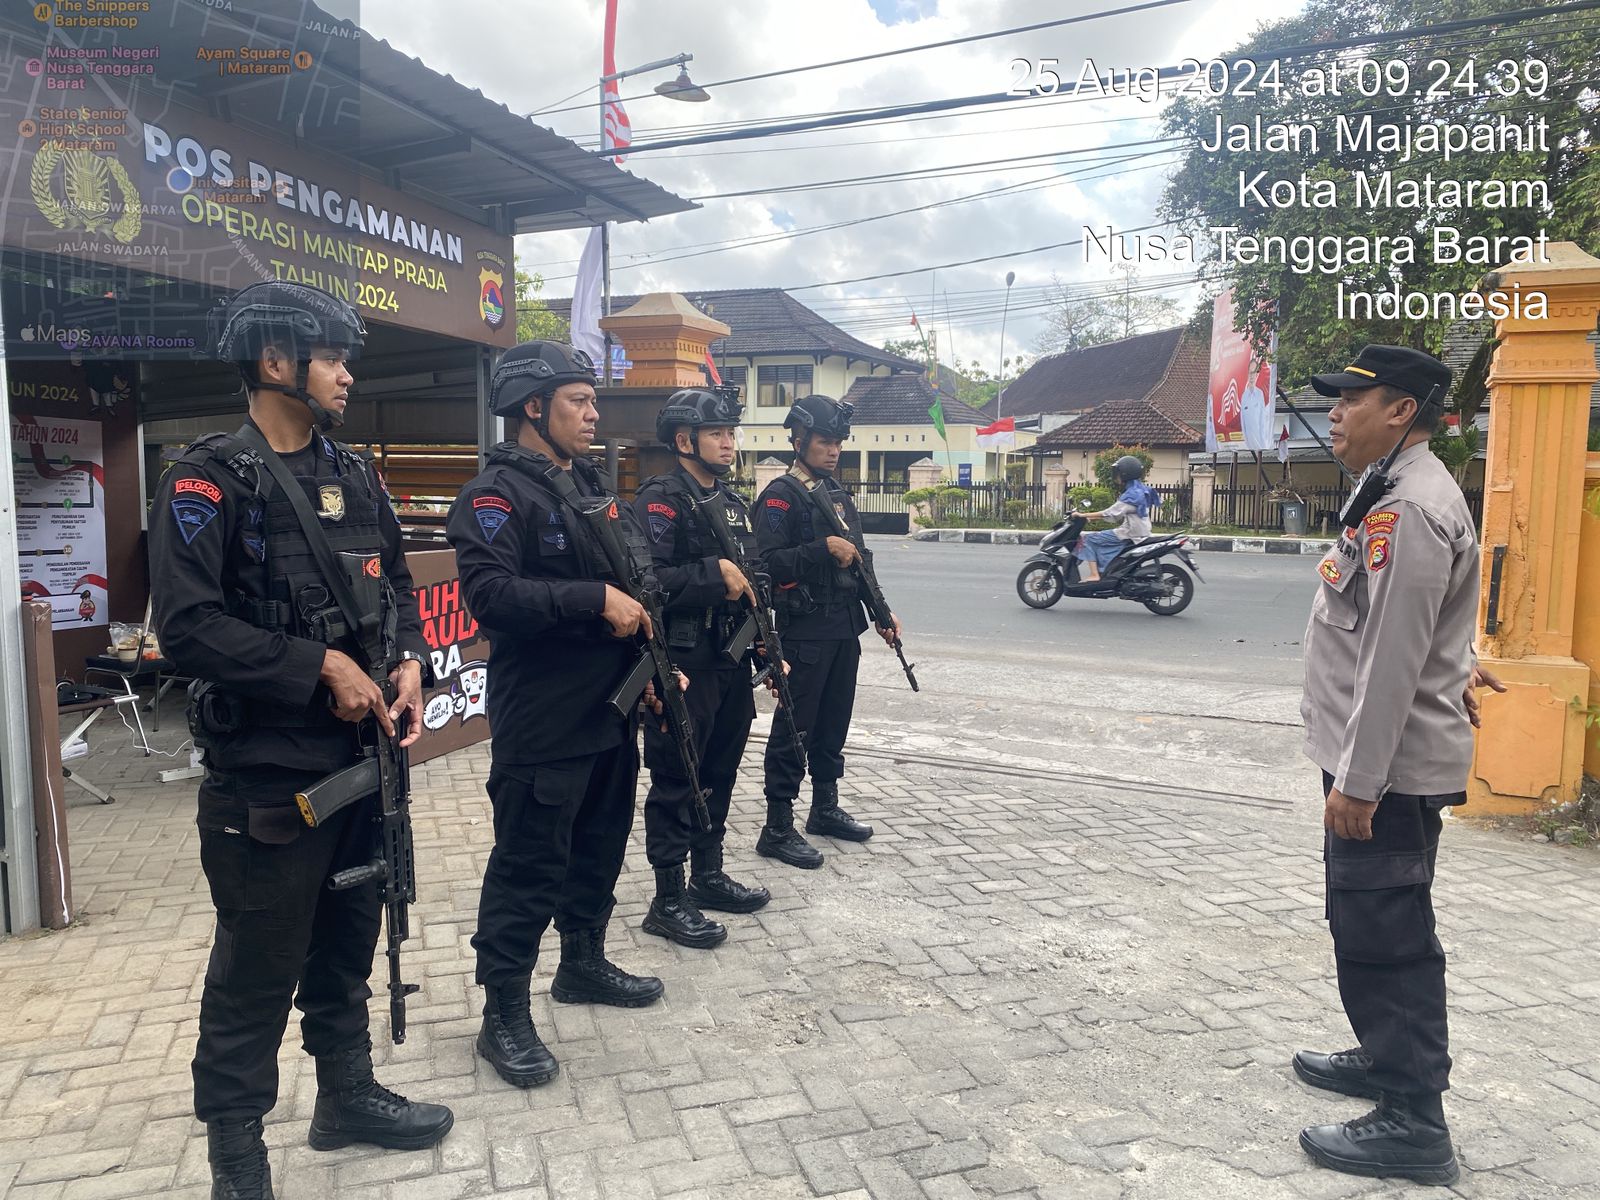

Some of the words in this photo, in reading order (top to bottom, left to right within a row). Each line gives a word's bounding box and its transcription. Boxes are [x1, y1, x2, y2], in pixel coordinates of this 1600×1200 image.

[144, 123, 233, 188] POS
[249, 161, 463, 264] PENGAMANAN
[182, 194, 297, 250] OPERASI
[303, 230, 389, 275] MANTAP
[394, 257, 447, 294] PRAJA
[270, 258, 351, 302] TAHUN
[353, 280, 399, 313] 2024
[40, 384, 79, 402] 2024
[51, 427, 79, 445] 2024
[179, 481, 220, 499] PELOPOR
[412, 580, 460, 621] LIH
